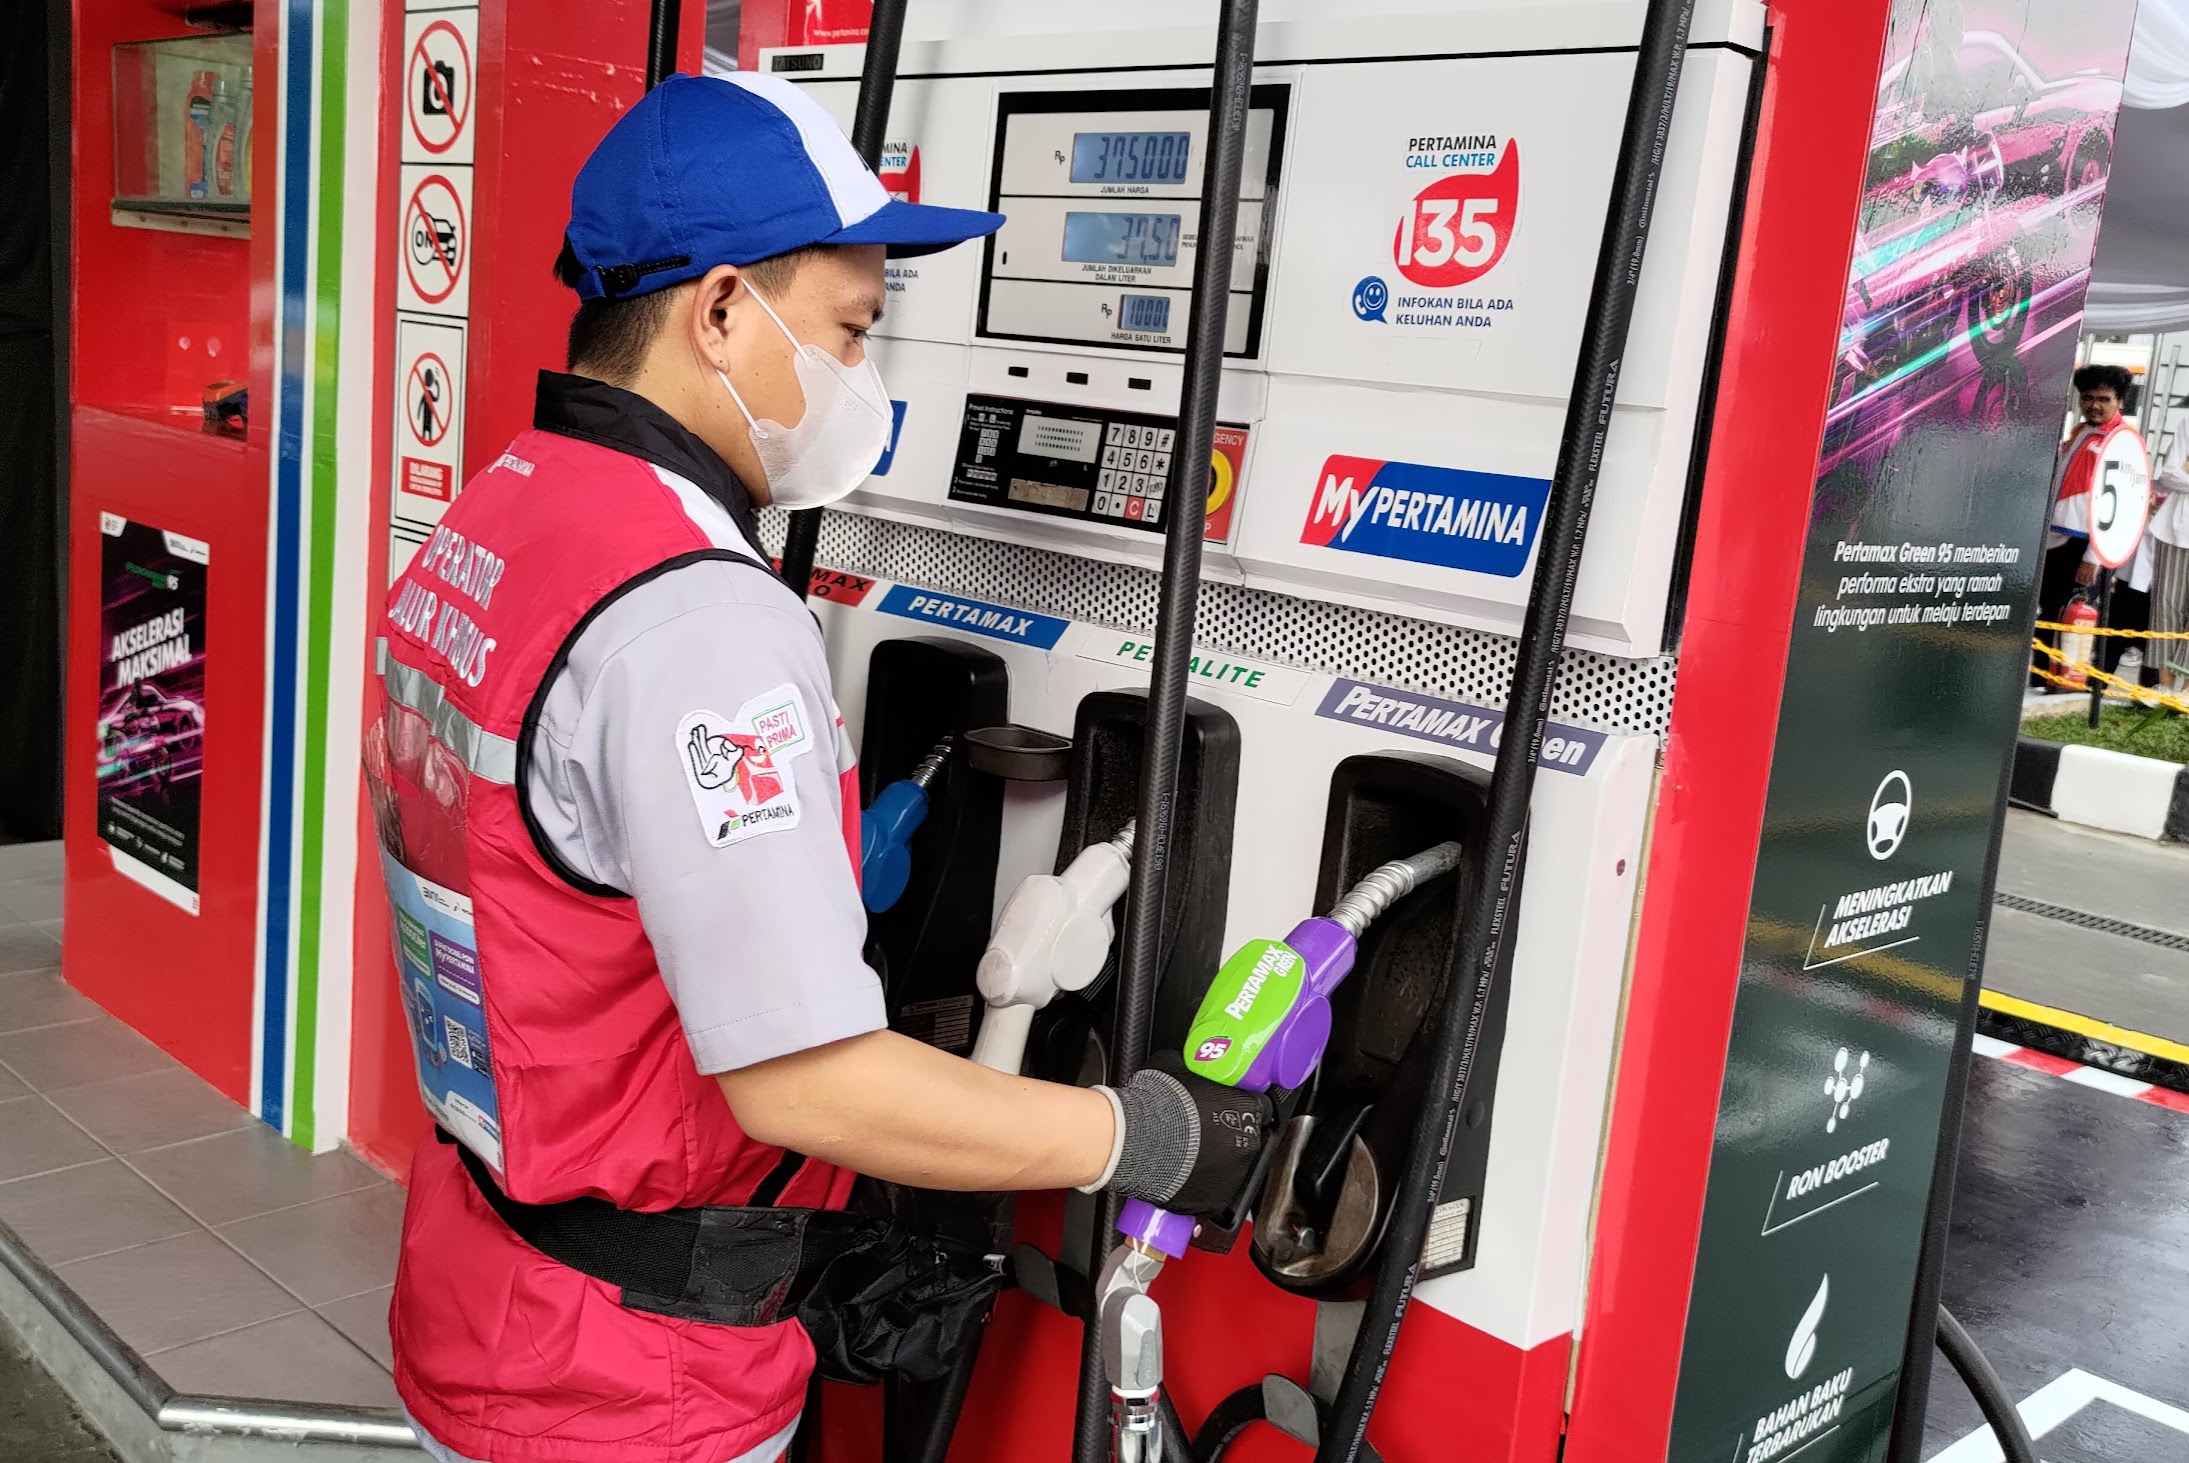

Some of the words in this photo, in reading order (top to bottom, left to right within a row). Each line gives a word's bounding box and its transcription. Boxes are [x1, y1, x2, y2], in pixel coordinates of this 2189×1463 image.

[1676, 28, 1685, 41] 1.7
[1408, 135, 1497, 152] PERTAMINA
[1055, 150, 1065, 165] Rp
[1094, 136, 1190, 179] 375000
[1406, 155, 1437, 168] CALL
[1442, 153, 1496, 168] CENTER
[1100, 186, 1126, 194] JUMLAH
[1127, 186, 1149, 194] HARGA
[1398, 198, 1498, 268] 135
[903, 269, 919, 279] ADA
[1082, 265, 1107, 274] JUMLAH
[1108, 266, 1152, 276] DIKELUARKAN
[1095, 273, 1117, 282] DALAM
[1118, 274, 1136, 283] LITER
[1101, 303, 1112, 318] Rp
[1397, 297, 1453, 309] INFOKAN
[1457, 298, 1484, 310] BILA
[1487, 299, 1514, 311] ADA
[1396, 314, 1452, 326] KELUHAN
[1455, 316, 1492, 328] ANDA
[1111, 332, 1134, 342] HARGA
[1135, 334, 1151, 342] SATU
[1152, 335, 1171, 344] LITER
[1588, 431, 1605, 472] FLEXSTEEL
[1598, 359, 1619, 425] FUTURA
[1112, 427, 1120, 442] 7
[1128, 429, 1136, 444] 8
[1145, 431, 1153, 446] 9
[1213, 433, 1245, 446] GENCY
[1107, 450, 1115, 465] 4
[1123, 452, 1132, 467] 5
[1140, 454, 1149, 470] 6
[1104, 473, 1110, 488] 1
[1118, 475, 1127, 491] 2
[1135, 478, 1144, 493] 3
[1097, 496, 1106, 511] 0
[1129, 501, 1139, 516] C
[2097, 460, 2119, 531] 5
[1313, 473, 1528, 545] MyPERTAMINA
[1834, 541, 1898, 562] Pertamax
[1899, 542, 1936, 563] Green
[1937, 543, 1954, 563] 95
[1953, 543, 2020, 564] memberikan
[1836, 572, 1898, 600] performa
[1899, 573, 1936, 593] ekstra
[1934, 575, 1967, 598] yang
[1967, 573, 2003, 593] ramah
[908, 596, 1034, 636] PERTAMAX
[1813, 605, 1886, 633] lingkungan
[1888, 603, 1921, 624] untuk
[1921, 601, 1962, 628] melaju
[1961, 602, 2011, 626] terdepan
[111, 607, 185, 662] AKSELERASI
[117, 633, 192, 689] MAKSIMAL
[1117, 641, 1266, 688] PEALITE
[759, 711, 790, 733] PASTI
[1334, 685, 1493, 744] PERTAMAX
[766, 725, 797, 748] PRIMA
[742, 804, 795, 827] PERTAMINA
[1490, 897, 1507, 934] FLEXSTEEL
[1500, 830, 1521, 891] FUTURA
[1833, 870, 1953, 920] MENINGKATKAN
[1824, 905, 1913, 949] AKSELERASI
[1224, 944, 1285, 1021] PERTAMAX
[1200, 1042, 1227, 1059] 95
[1786, 1164, 1826, 1200] RON
[1823, 1137, 1890, 1184] BOOSTER
[1395, 1262, 1417, 1317] FUTURA
[1752, 1391, 1811, 1443] BAHAN
[1810, 1366, 1853, 1409] BAKU
[1746, 1394, 1845, 1463] TERBARUKAN
